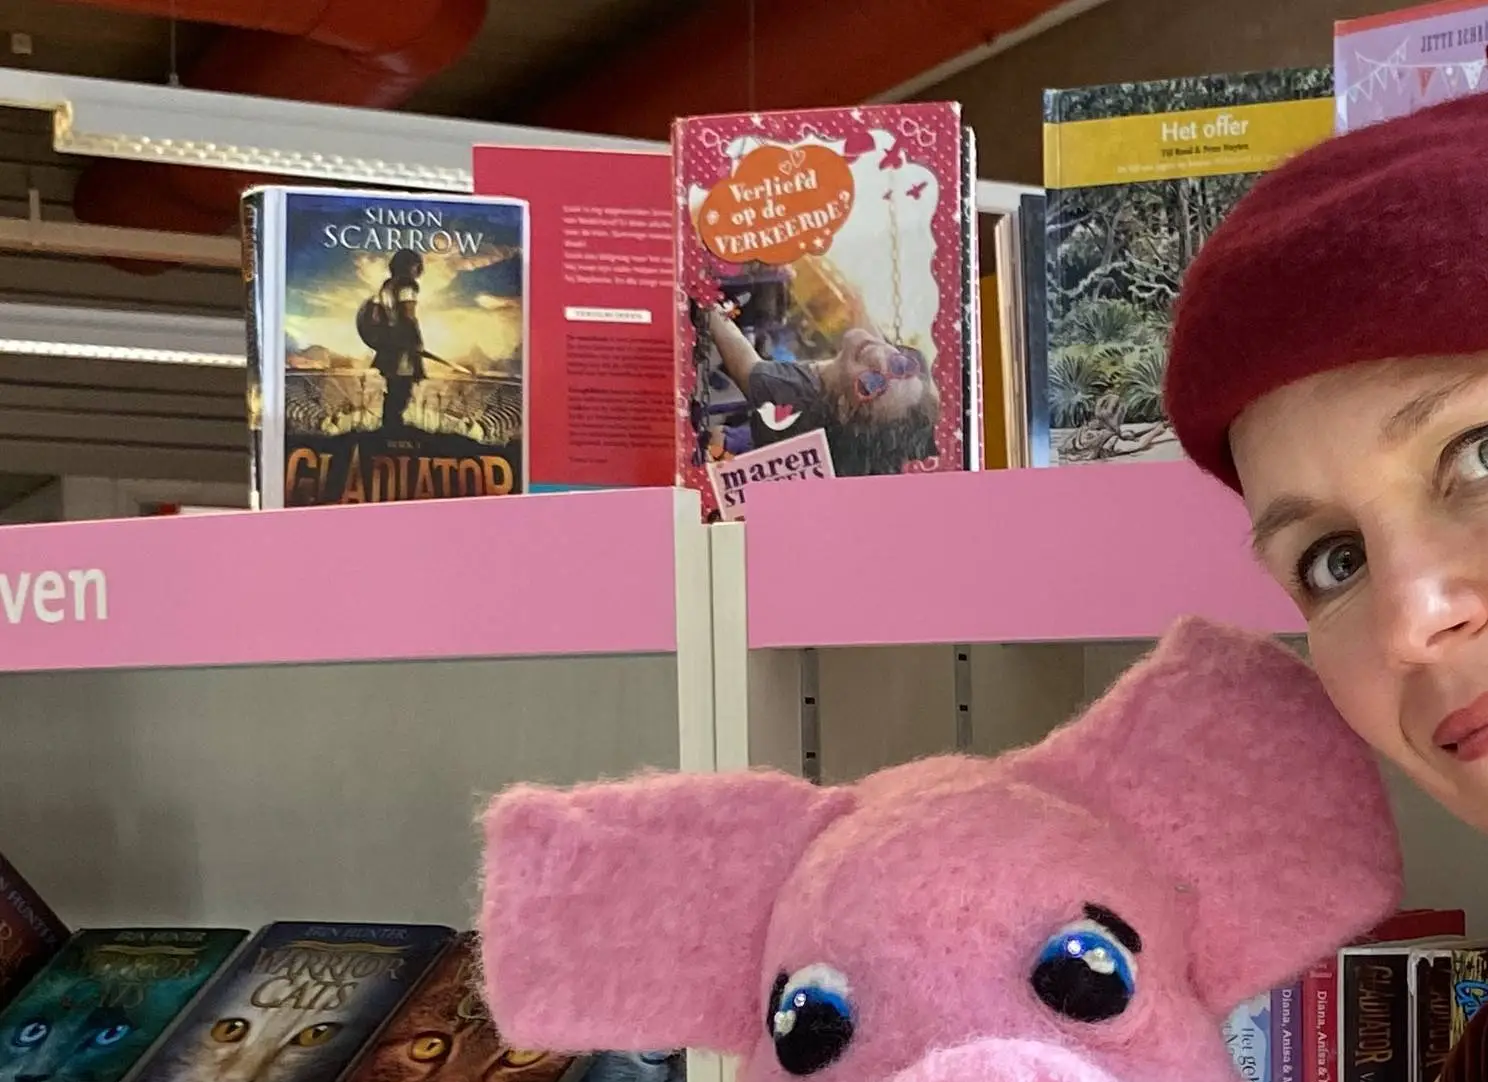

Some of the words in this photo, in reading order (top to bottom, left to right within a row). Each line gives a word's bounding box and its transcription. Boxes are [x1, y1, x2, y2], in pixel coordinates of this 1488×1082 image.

[1420, 31, 1454, 53] JETTE
[1161, 121, 1197, 142] Het
[1203, 113, 1249, 138] offer
[729, 169, 817, 203] Verliefd
[365, 207, 443, 228] SIMON
[715, 191, 850, 255] VERKEERDE?
[731, 208, 757, 226] op
[762, 201, 786, 220] de
[323, 224, 484, 255] SCARROW
[285, 444, 515, 507] GLADIATOR
[720, 448, 821, 490] maren
[254, 947, 406, 981] WARRIOR
[250, 976, 359, 1010] CATS
[1280, 989, 1293, 1028] Diana,
[1315, 990, 1328, 1029] Diana,
[1354, 964, 1394, 1067] GLADIATOR
[1282, 1031, 1293, 1063] Anisa
[1316, 1033, 1328, 1065] Anisa
